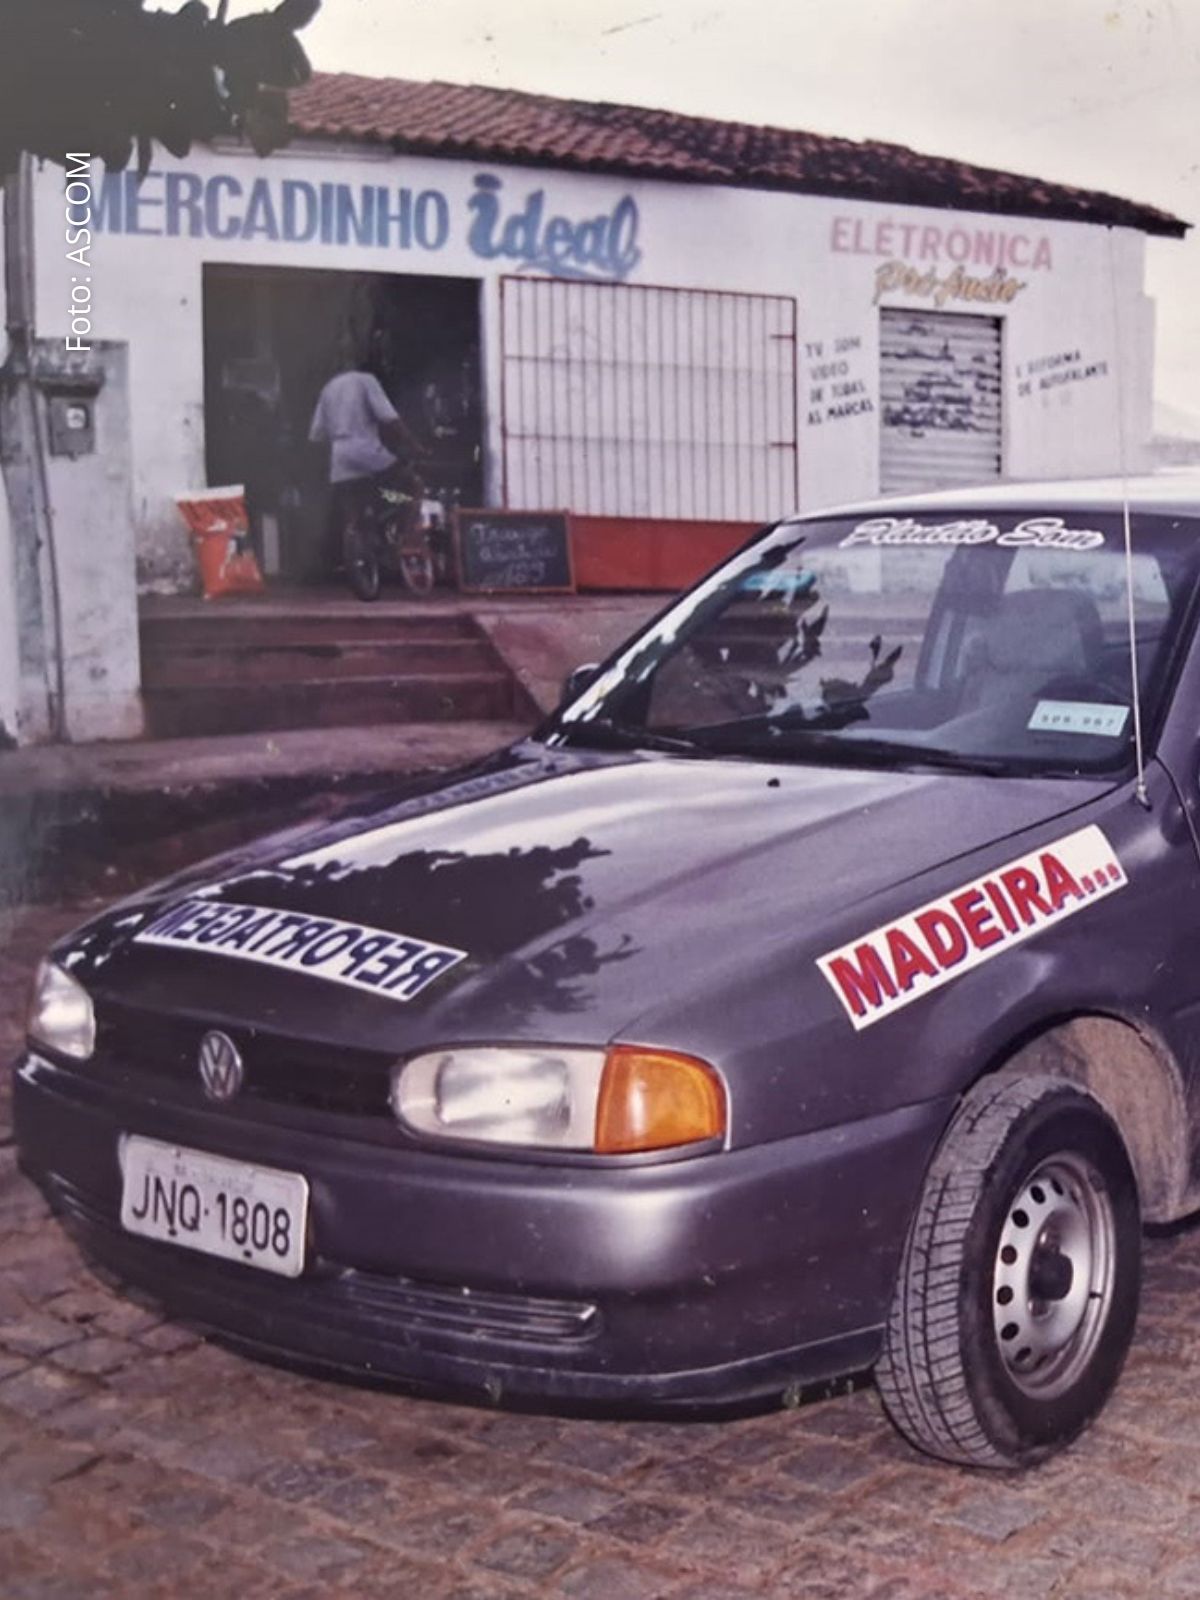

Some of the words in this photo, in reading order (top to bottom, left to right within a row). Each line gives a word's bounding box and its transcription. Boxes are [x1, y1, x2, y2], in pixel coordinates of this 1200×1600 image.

[70, 167, 450, 251] MERCADINHO
[467, 172, 642, 284] ideal
[826, 398, 874, 422] MARCAS
[828, 851, 1123, 1017] MADEIRA...
